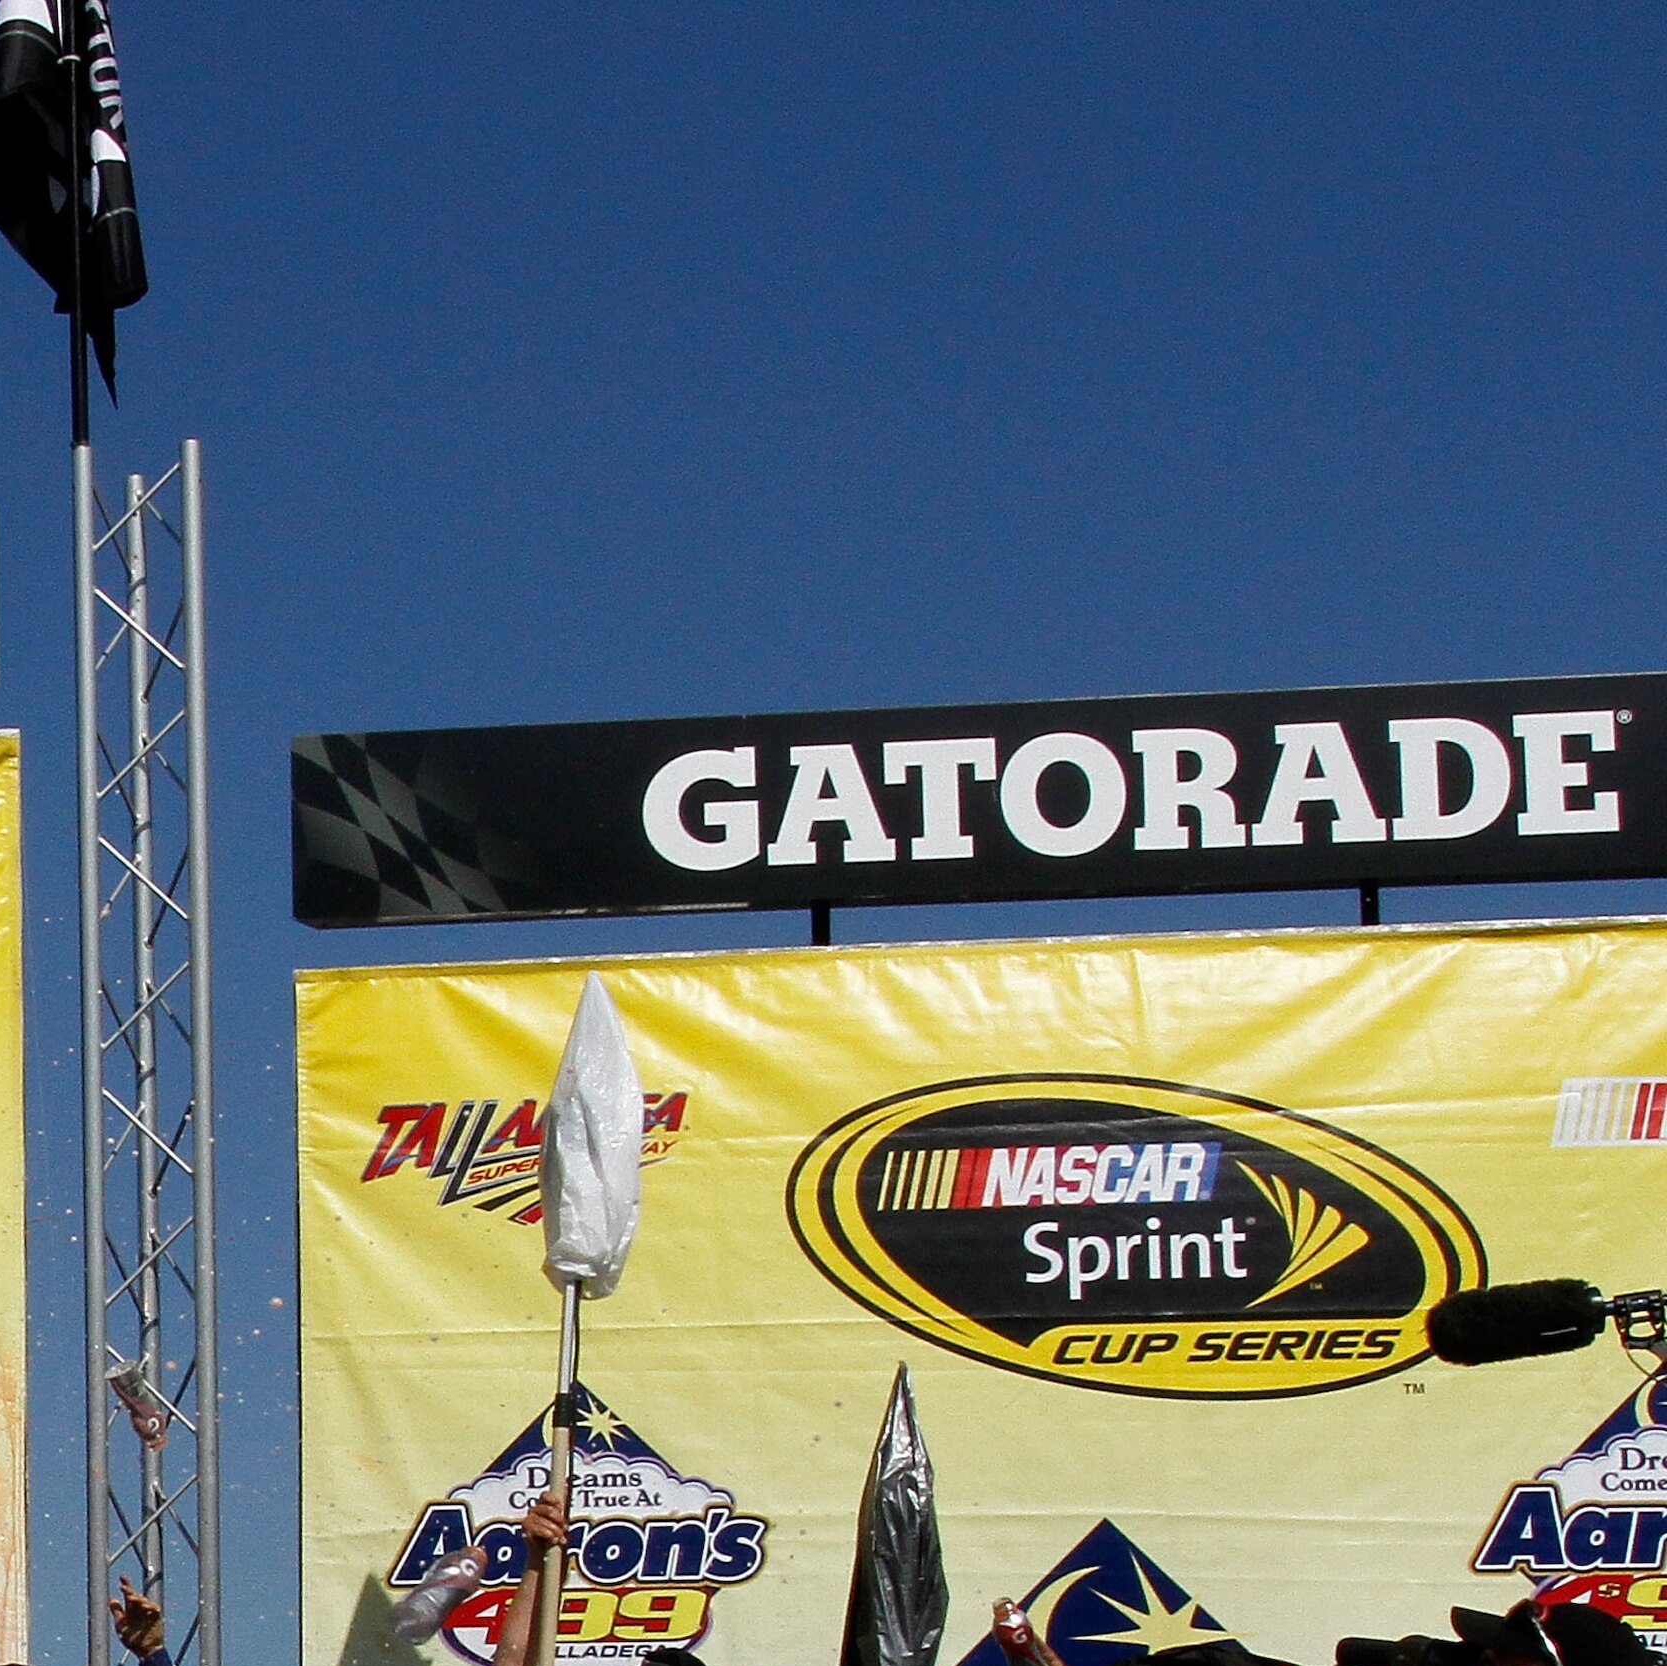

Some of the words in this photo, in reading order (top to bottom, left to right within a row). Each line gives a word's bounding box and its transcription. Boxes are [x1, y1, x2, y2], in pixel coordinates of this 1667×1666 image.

[642, 711, 1621, 869] GATORADE
[983, 1146, 1207, 1206] NASCAR
[1024, 1218, 1248, 1301] Sprint
[1053, 1330, 1178, 1365] CUP
[1188, 1328, 1400, 1361] SERIES
[527, 1467, 642, 1489] Deams
[1602, 1472, 1667, 1491] Come
[578, 1490, 632, 1508] True
[636, 1490, 662, 1507] At
